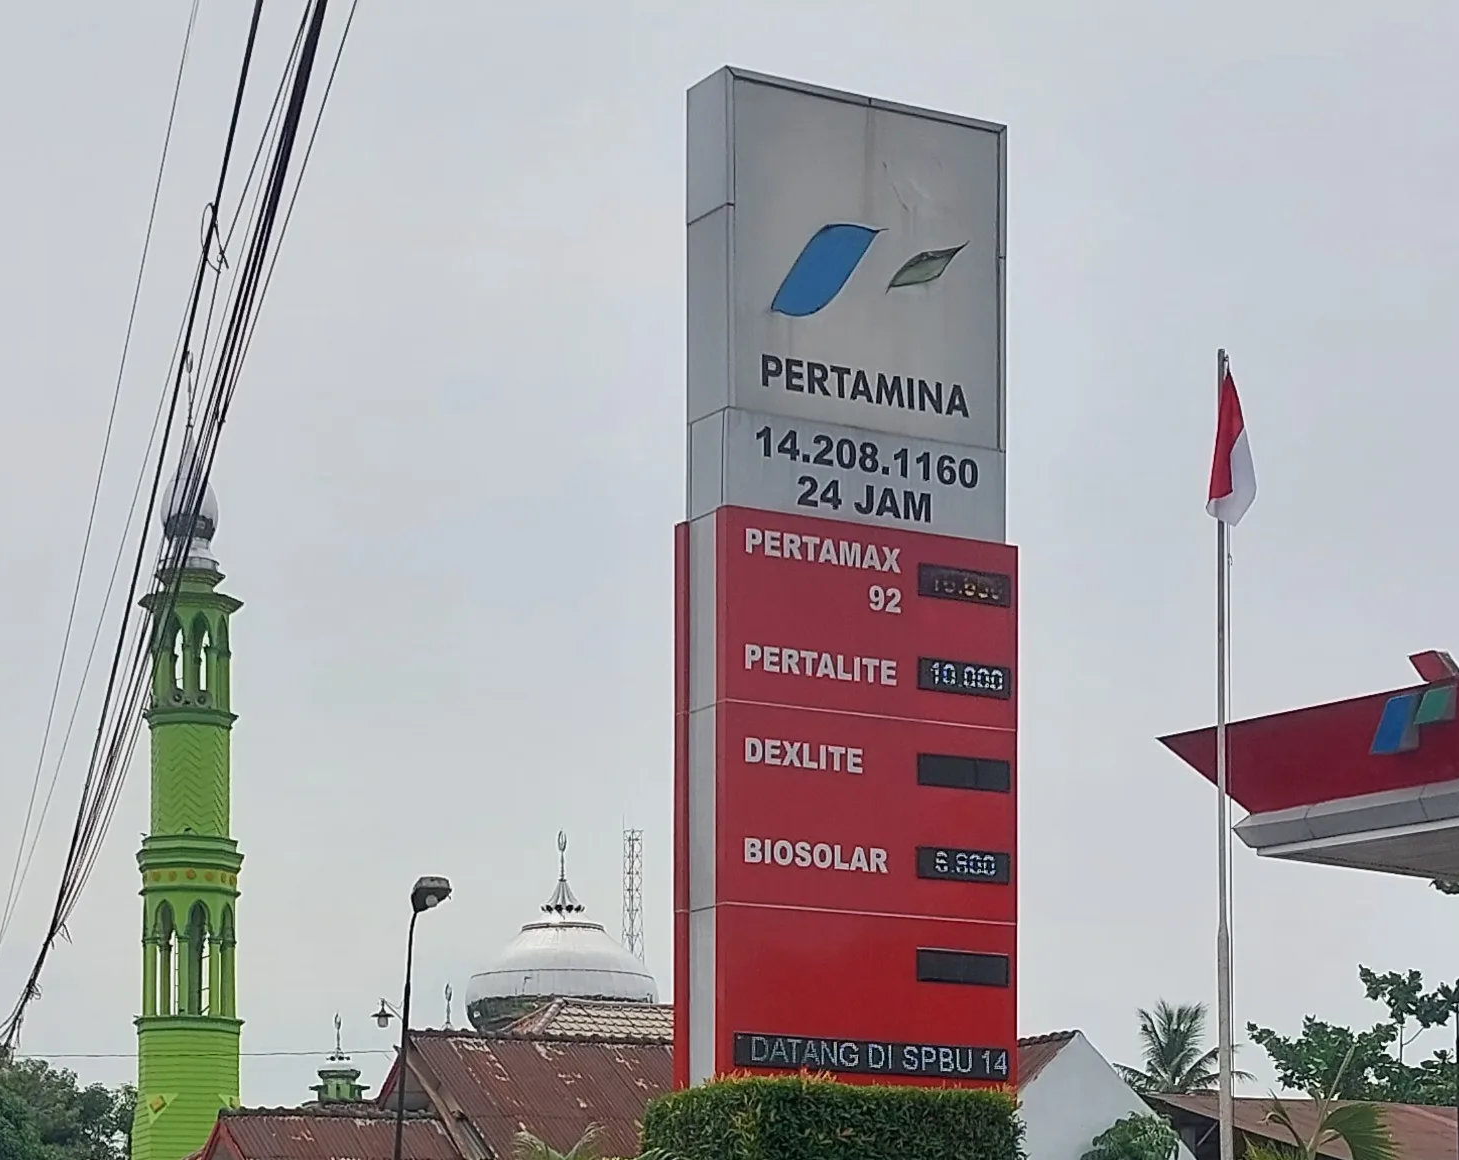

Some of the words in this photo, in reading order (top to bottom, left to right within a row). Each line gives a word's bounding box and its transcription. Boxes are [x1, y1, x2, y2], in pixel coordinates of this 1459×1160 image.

[761, 354, 970, 418] PERTAMINA
[755, 426, 979, 488] 14.208.1160
[797, 475, 842, 510] 24
[854, 485, 932, 523] JAM
[744, 528, 901, 574] PERTAMAX
[868, 585, 902, 614] 92
[744, 644, 897, 687] PERTALITE
[930, 662, 1003, 690] 10.000
[744, 737, 864, 775] DEXLITE
[744, 837, 889, 874] BIOSOLAR
[750, 1036, 860, 1068] DATANG
[868, 1043, 892, 1069] DI
[902, 1046, 973, 1074] SPBU
[981, 1050, 1008, 1075] 14
